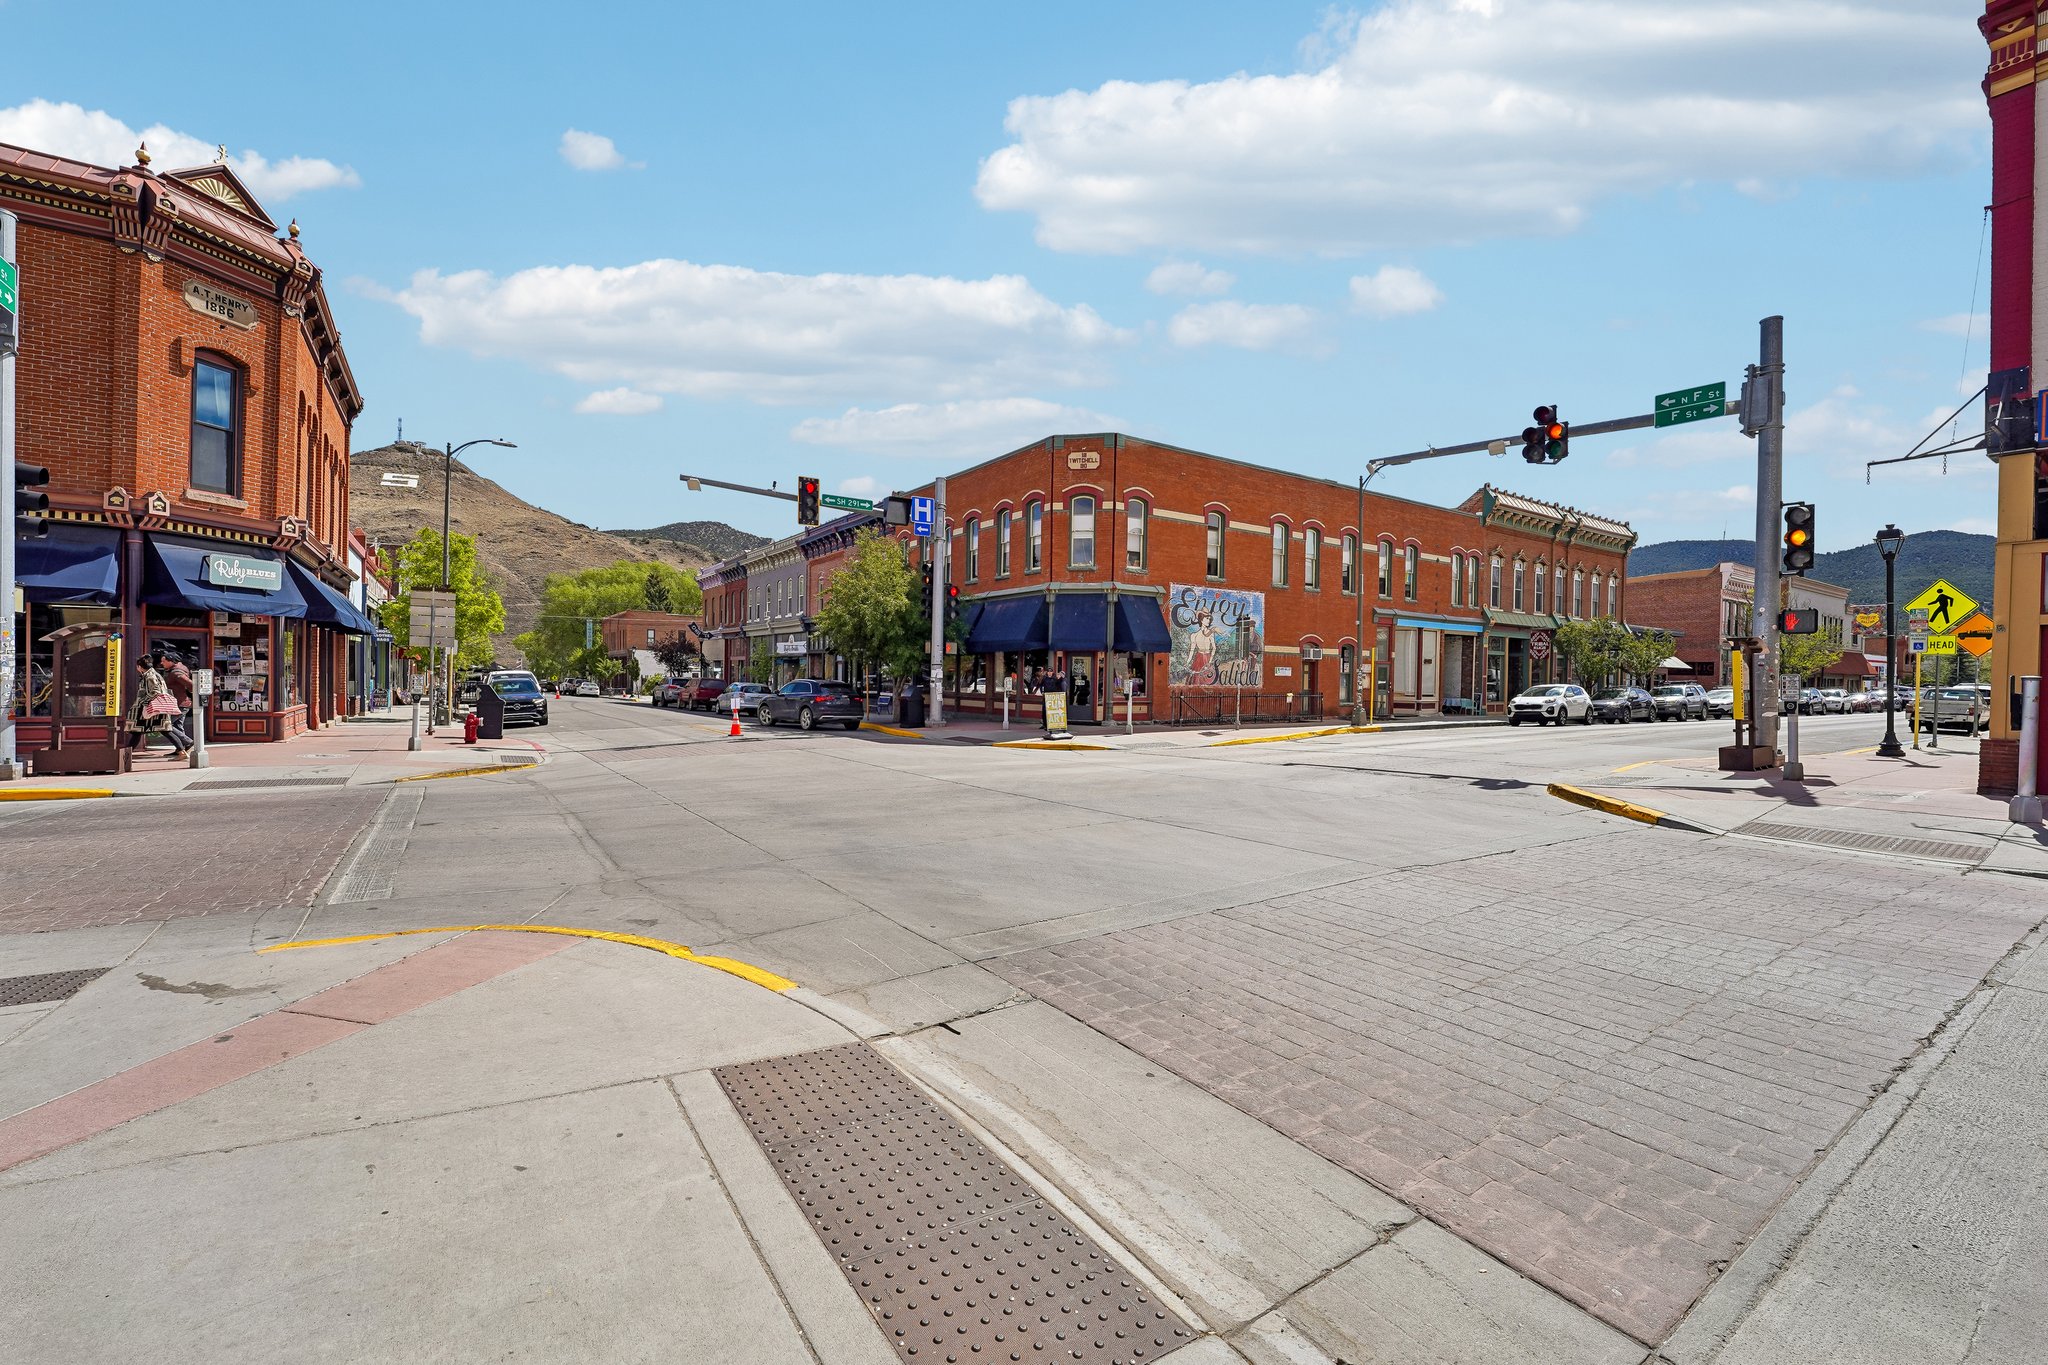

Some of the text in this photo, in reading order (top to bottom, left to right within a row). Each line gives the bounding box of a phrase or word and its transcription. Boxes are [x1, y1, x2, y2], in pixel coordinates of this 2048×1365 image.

[1, 268, 8, 281] St
[205, 300, 235, 319] 1886
[1681, 390, 1720, 404] N F St
[1671, 410, 1697, 421] F St
[836, 497, 860, 507] SH 291
[914, 498, 931, 522] H
[214, 558, 277, 584] Ruby BLUES
[1170, 587, 1246, 628] Enjoy
[1928, 641, 1954, 649] HEAD
[1204, 659, 1259, 686] Salida
[1047, 700, 1065, 709] FUN
[1047, 713, 1065, 723] ART
